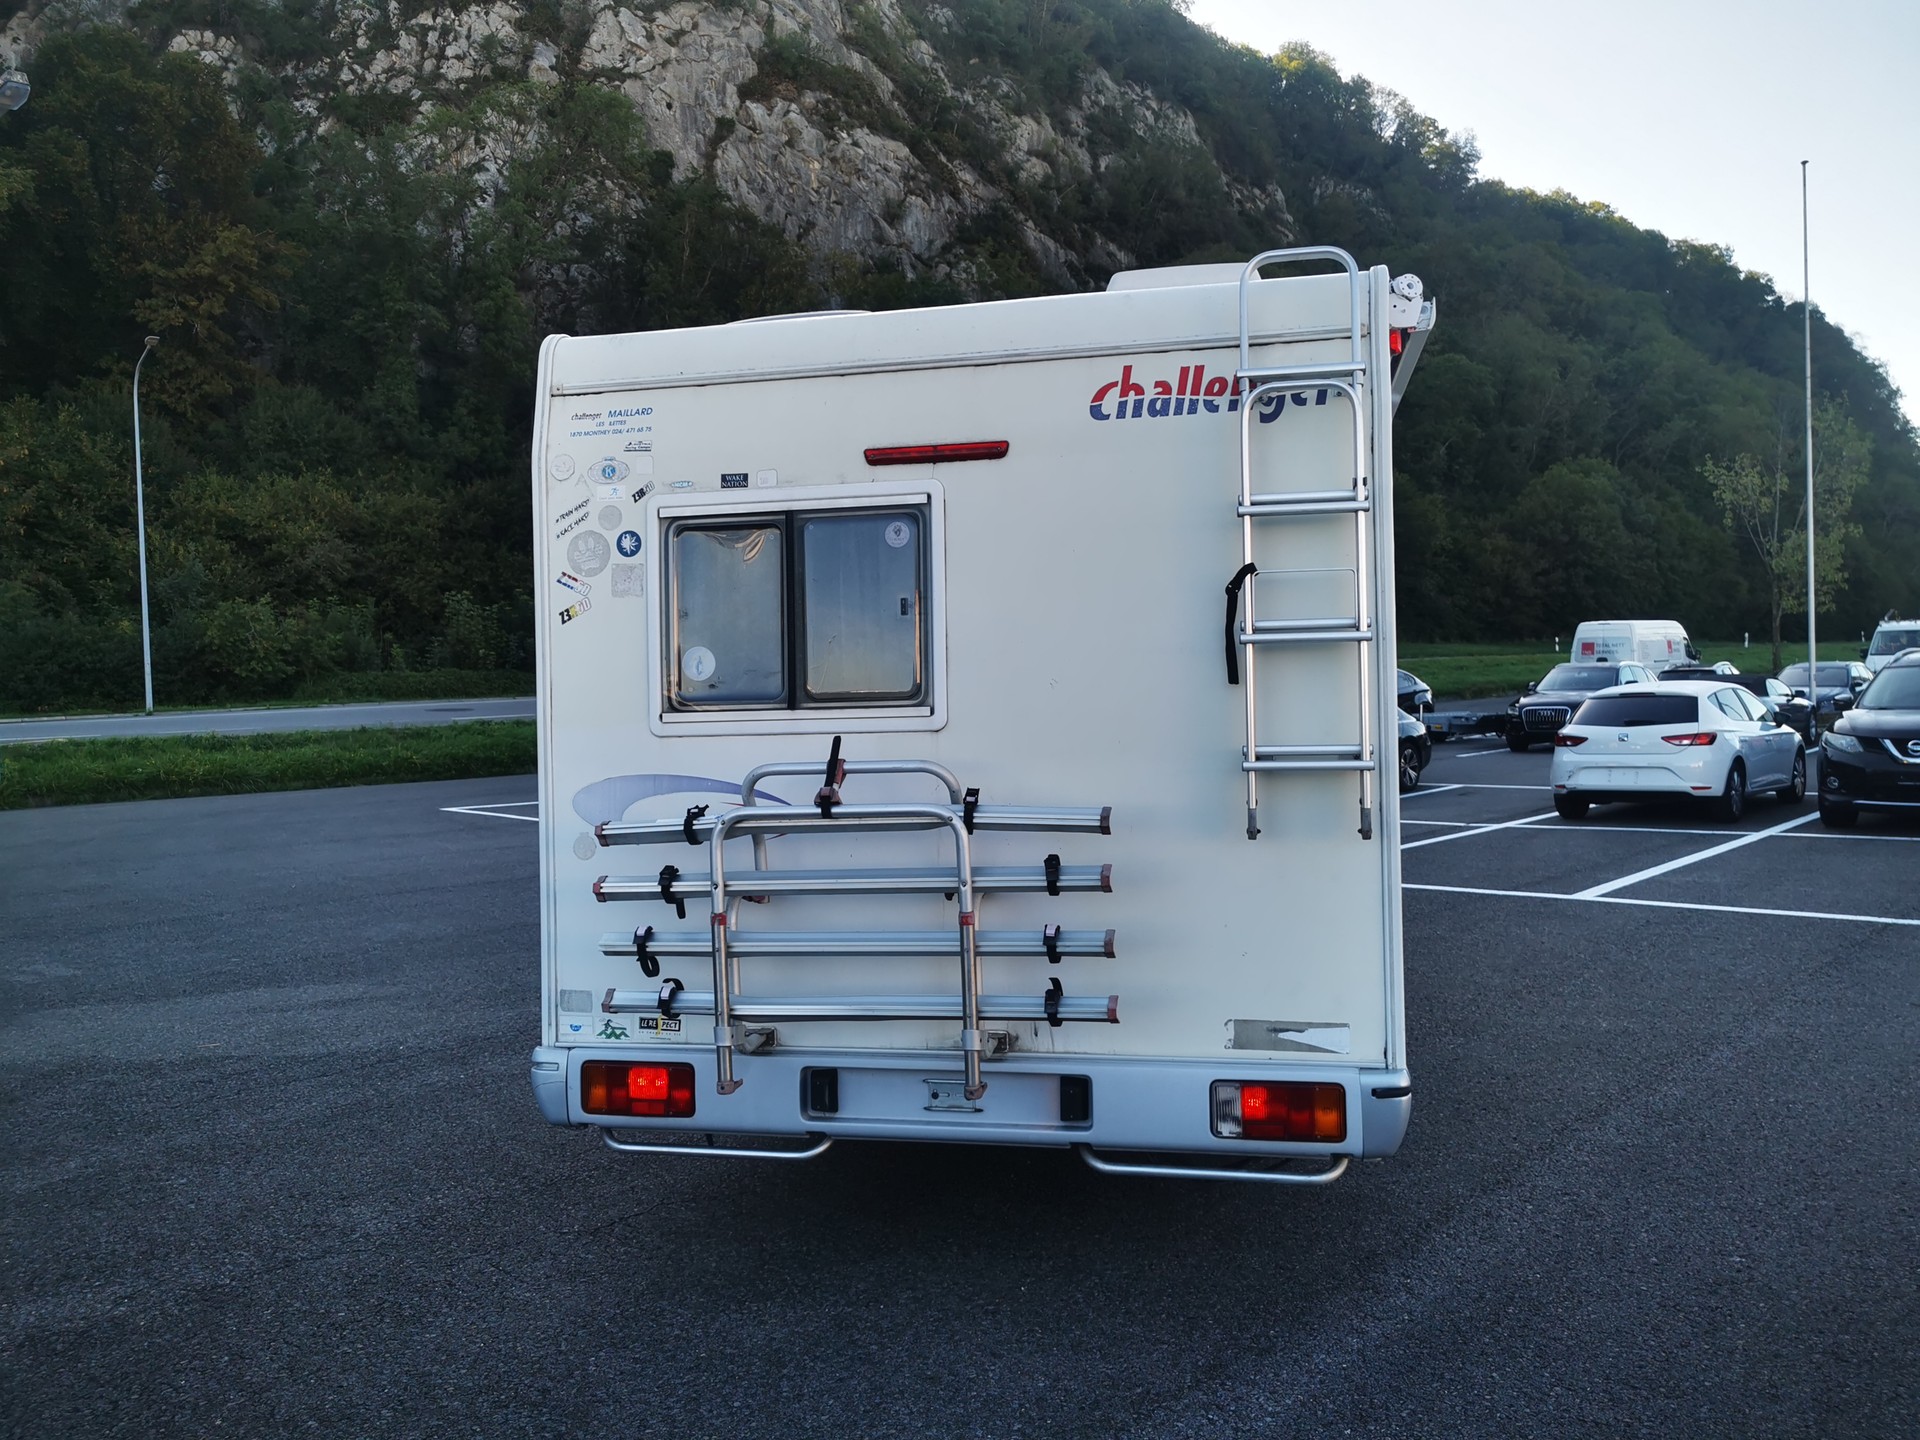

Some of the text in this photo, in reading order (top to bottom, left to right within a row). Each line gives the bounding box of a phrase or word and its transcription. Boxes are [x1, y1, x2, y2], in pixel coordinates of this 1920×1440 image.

[608, 407, 653, 418] MAILLARD
[721, 480, 748, 488] NATION
[641, 1019, 648, 1027] LE
